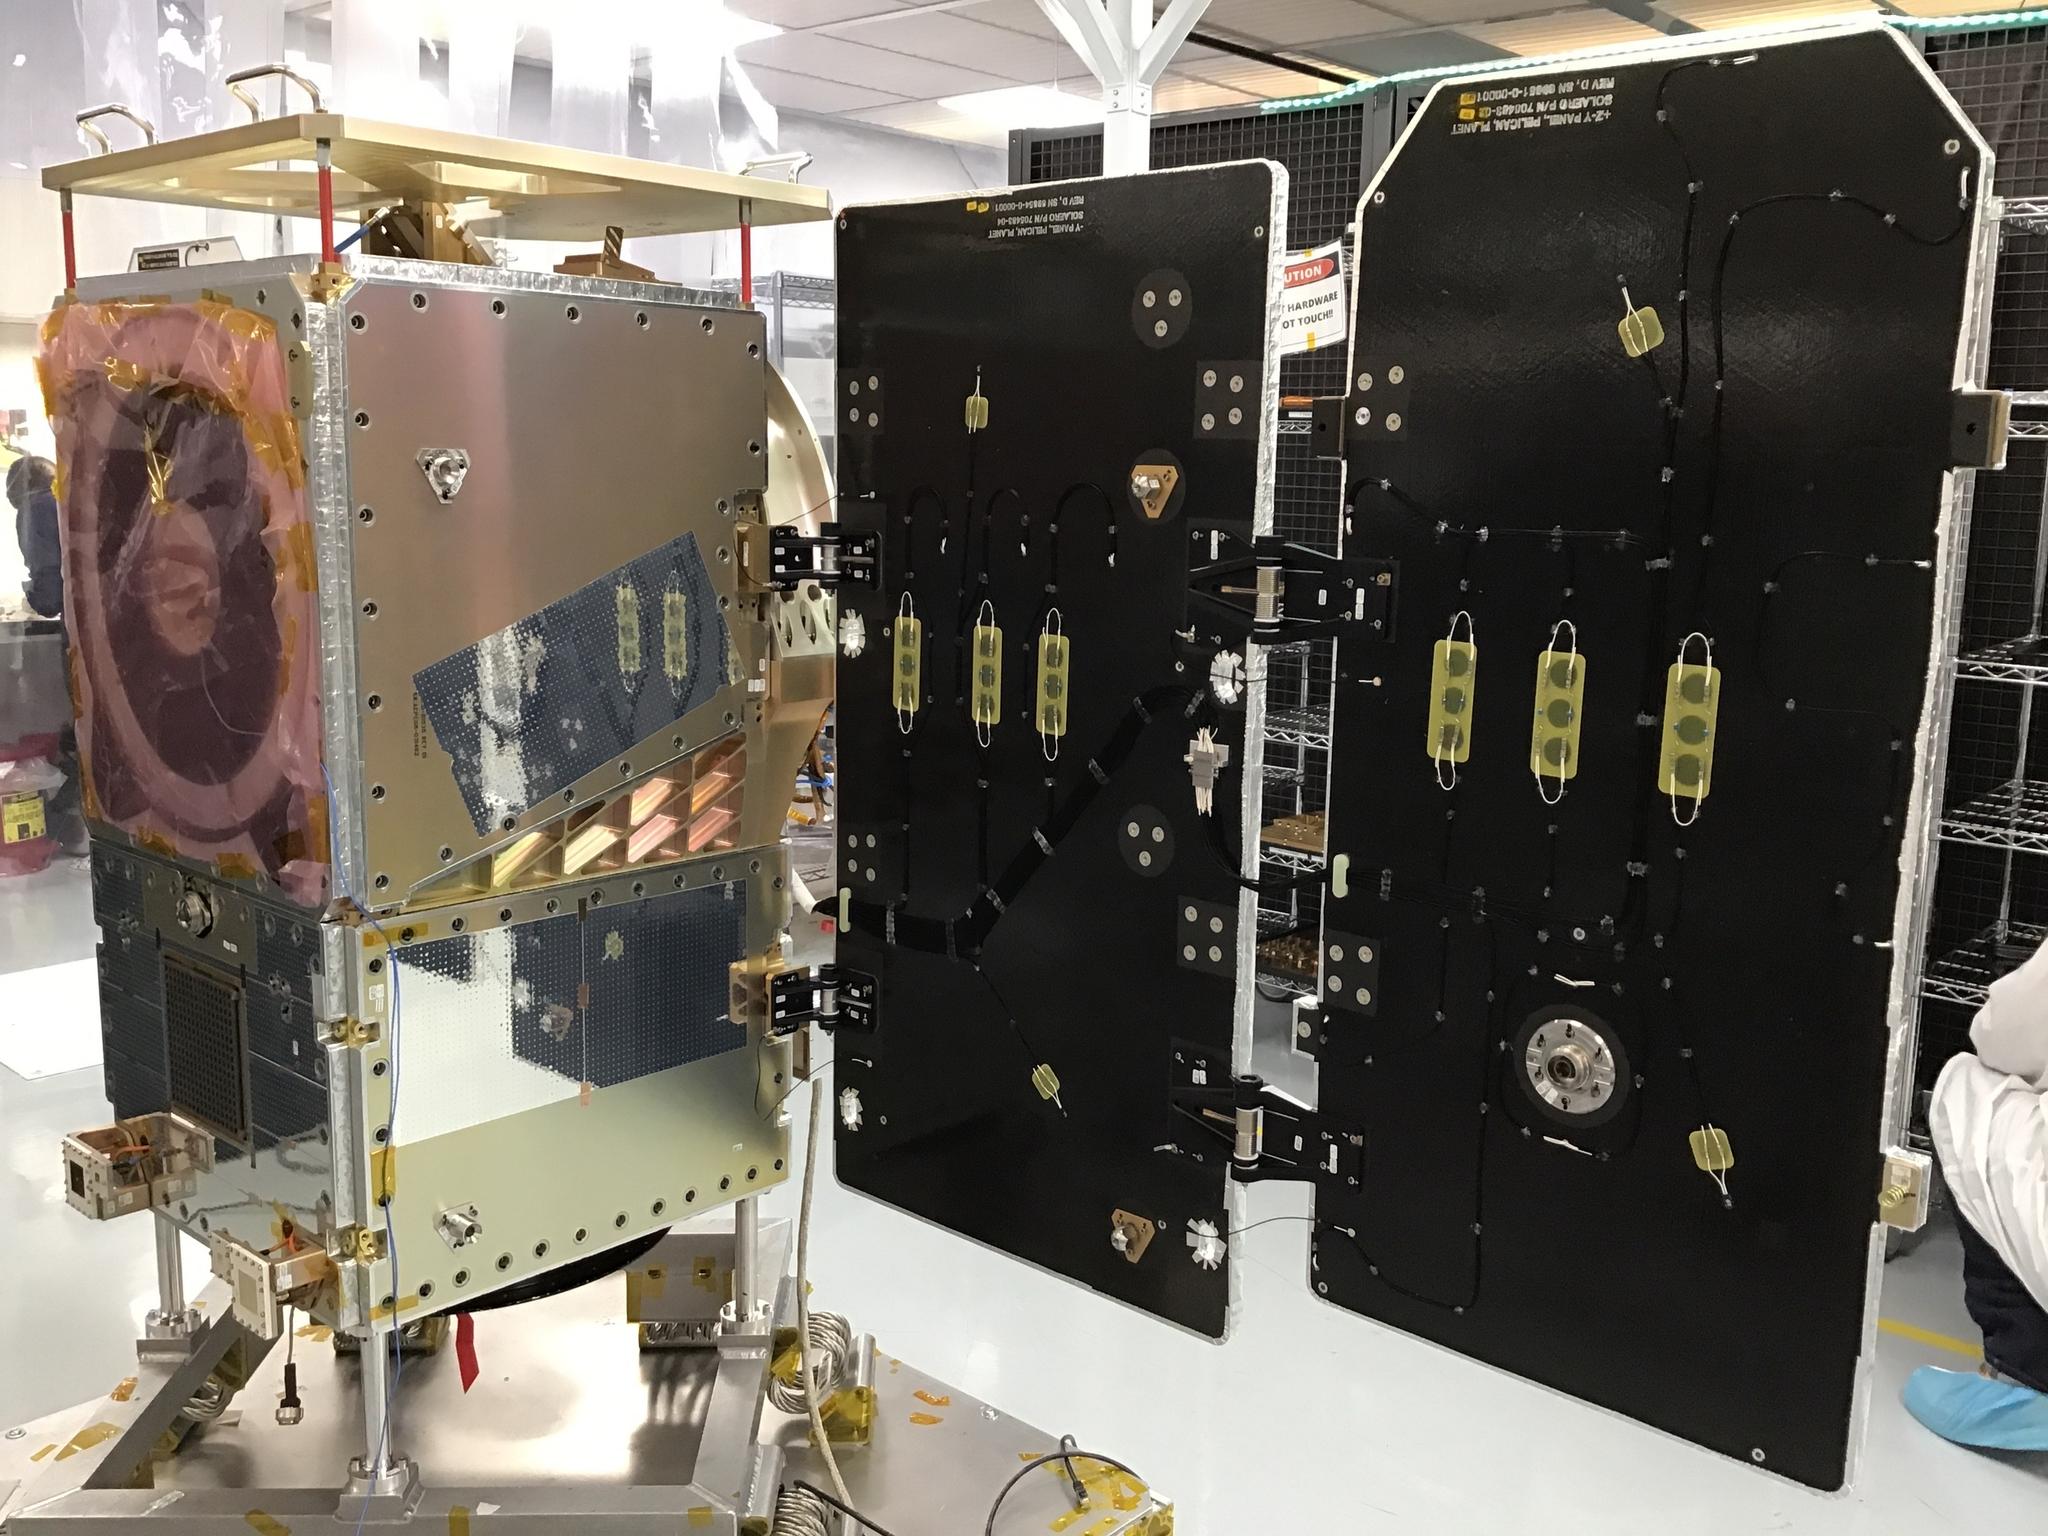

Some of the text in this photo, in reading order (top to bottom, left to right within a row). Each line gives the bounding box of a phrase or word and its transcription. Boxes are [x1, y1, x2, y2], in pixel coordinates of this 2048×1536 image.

[1558, 82, 1574, 94] SN
[1576, 79, 1590, 90] D,
[1591, 77, 1615, 90] REV
[1536, 100, 1557, 113] P/N
[1559, 94, 1613, 110] SOLAERO
[1450, 110, 1611, 135] +Z-Y PANEL, PELICAN, PLANET
[1047, 198, 1058, 207] SN
[1069, 195, 1084, 205] REV
[1034, 214, 1048, 223] P/N
[1049, 211, 1084, 222] SOLAERO
[988, 223, 1084, 239] -Y PANEL, PELICAN, PLANET
[1284, 265, 1322, 283] UTION
[1287, 291, 1338, 313] HARDWARE
[1282, 319, 1295, 329] OT
[1298, 308, 1334, 326] TOUCH!!
